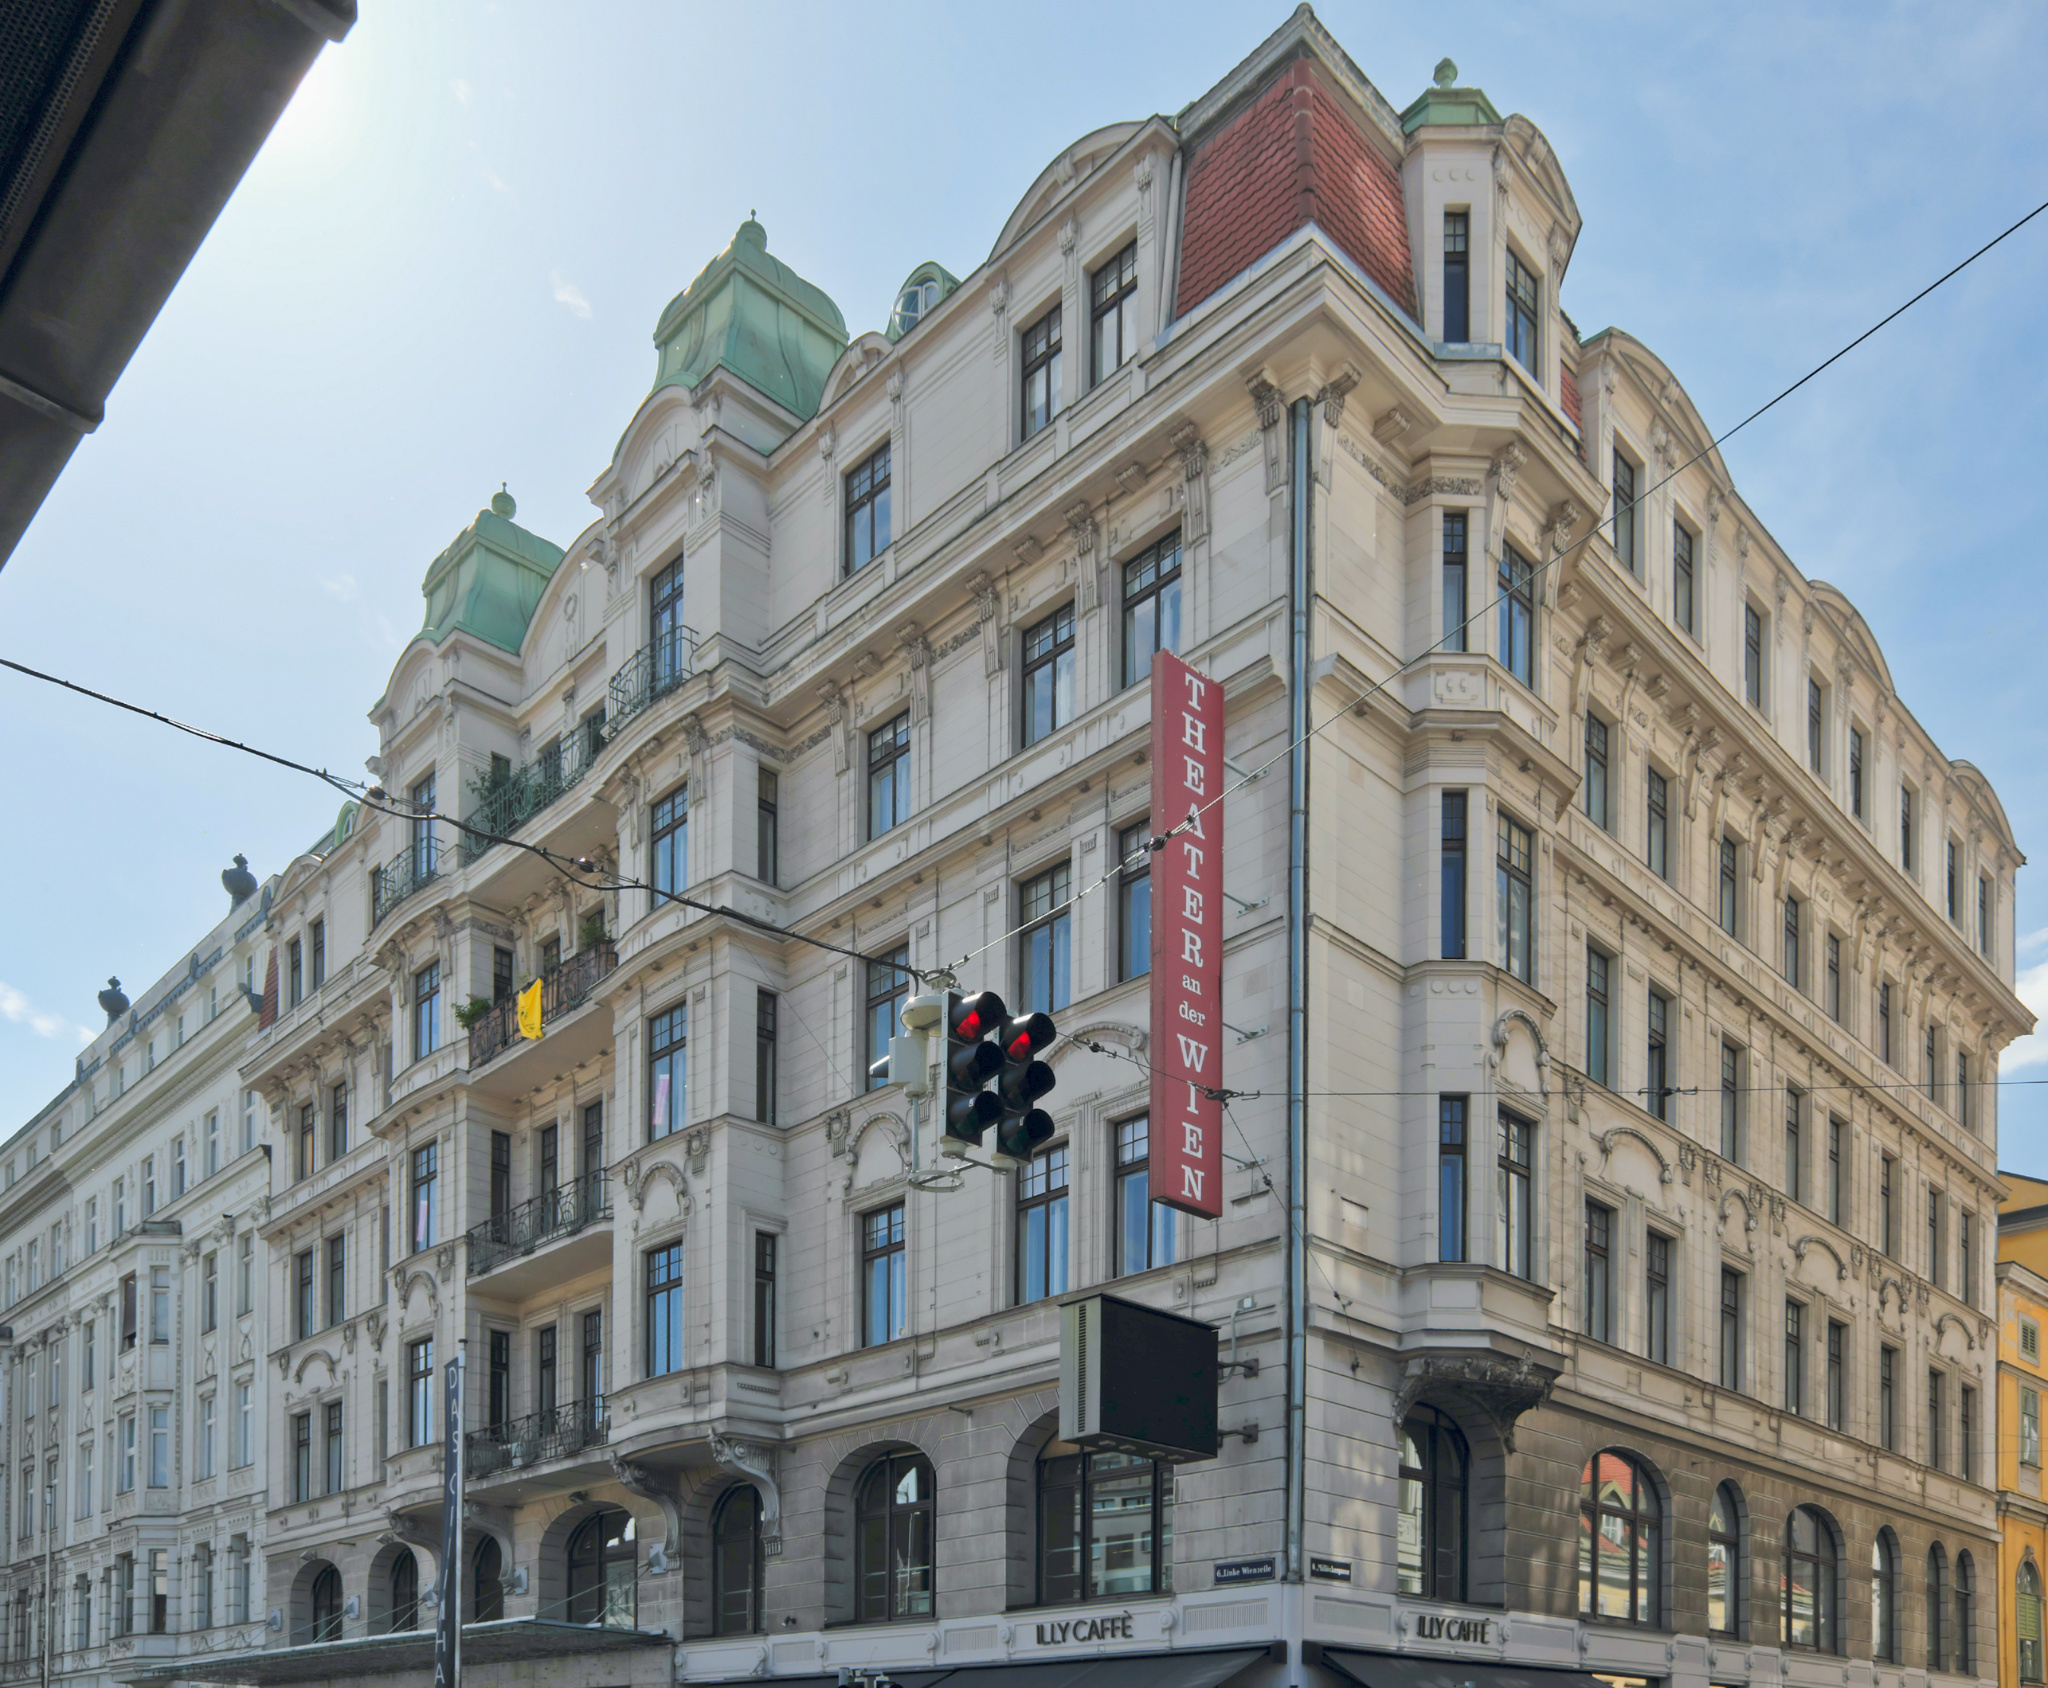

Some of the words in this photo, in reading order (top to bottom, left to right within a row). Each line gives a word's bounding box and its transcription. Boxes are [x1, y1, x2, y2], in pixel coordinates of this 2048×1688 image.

[1181, 671, 1206, 968] THEATER
[1182, 974, 1202, 996] an
[1179, 1000, 1206, 1027] der
[1177, 1033, 1208, 1202] WIEN
[449, 1366, 459, 1454] DAS
[1241, 1564, 1272, 1575] Wienzeile
[1036, 1621, 1070, 1646] ILLY
[1072, 1610, 1133, 1642] CAFFÈ
